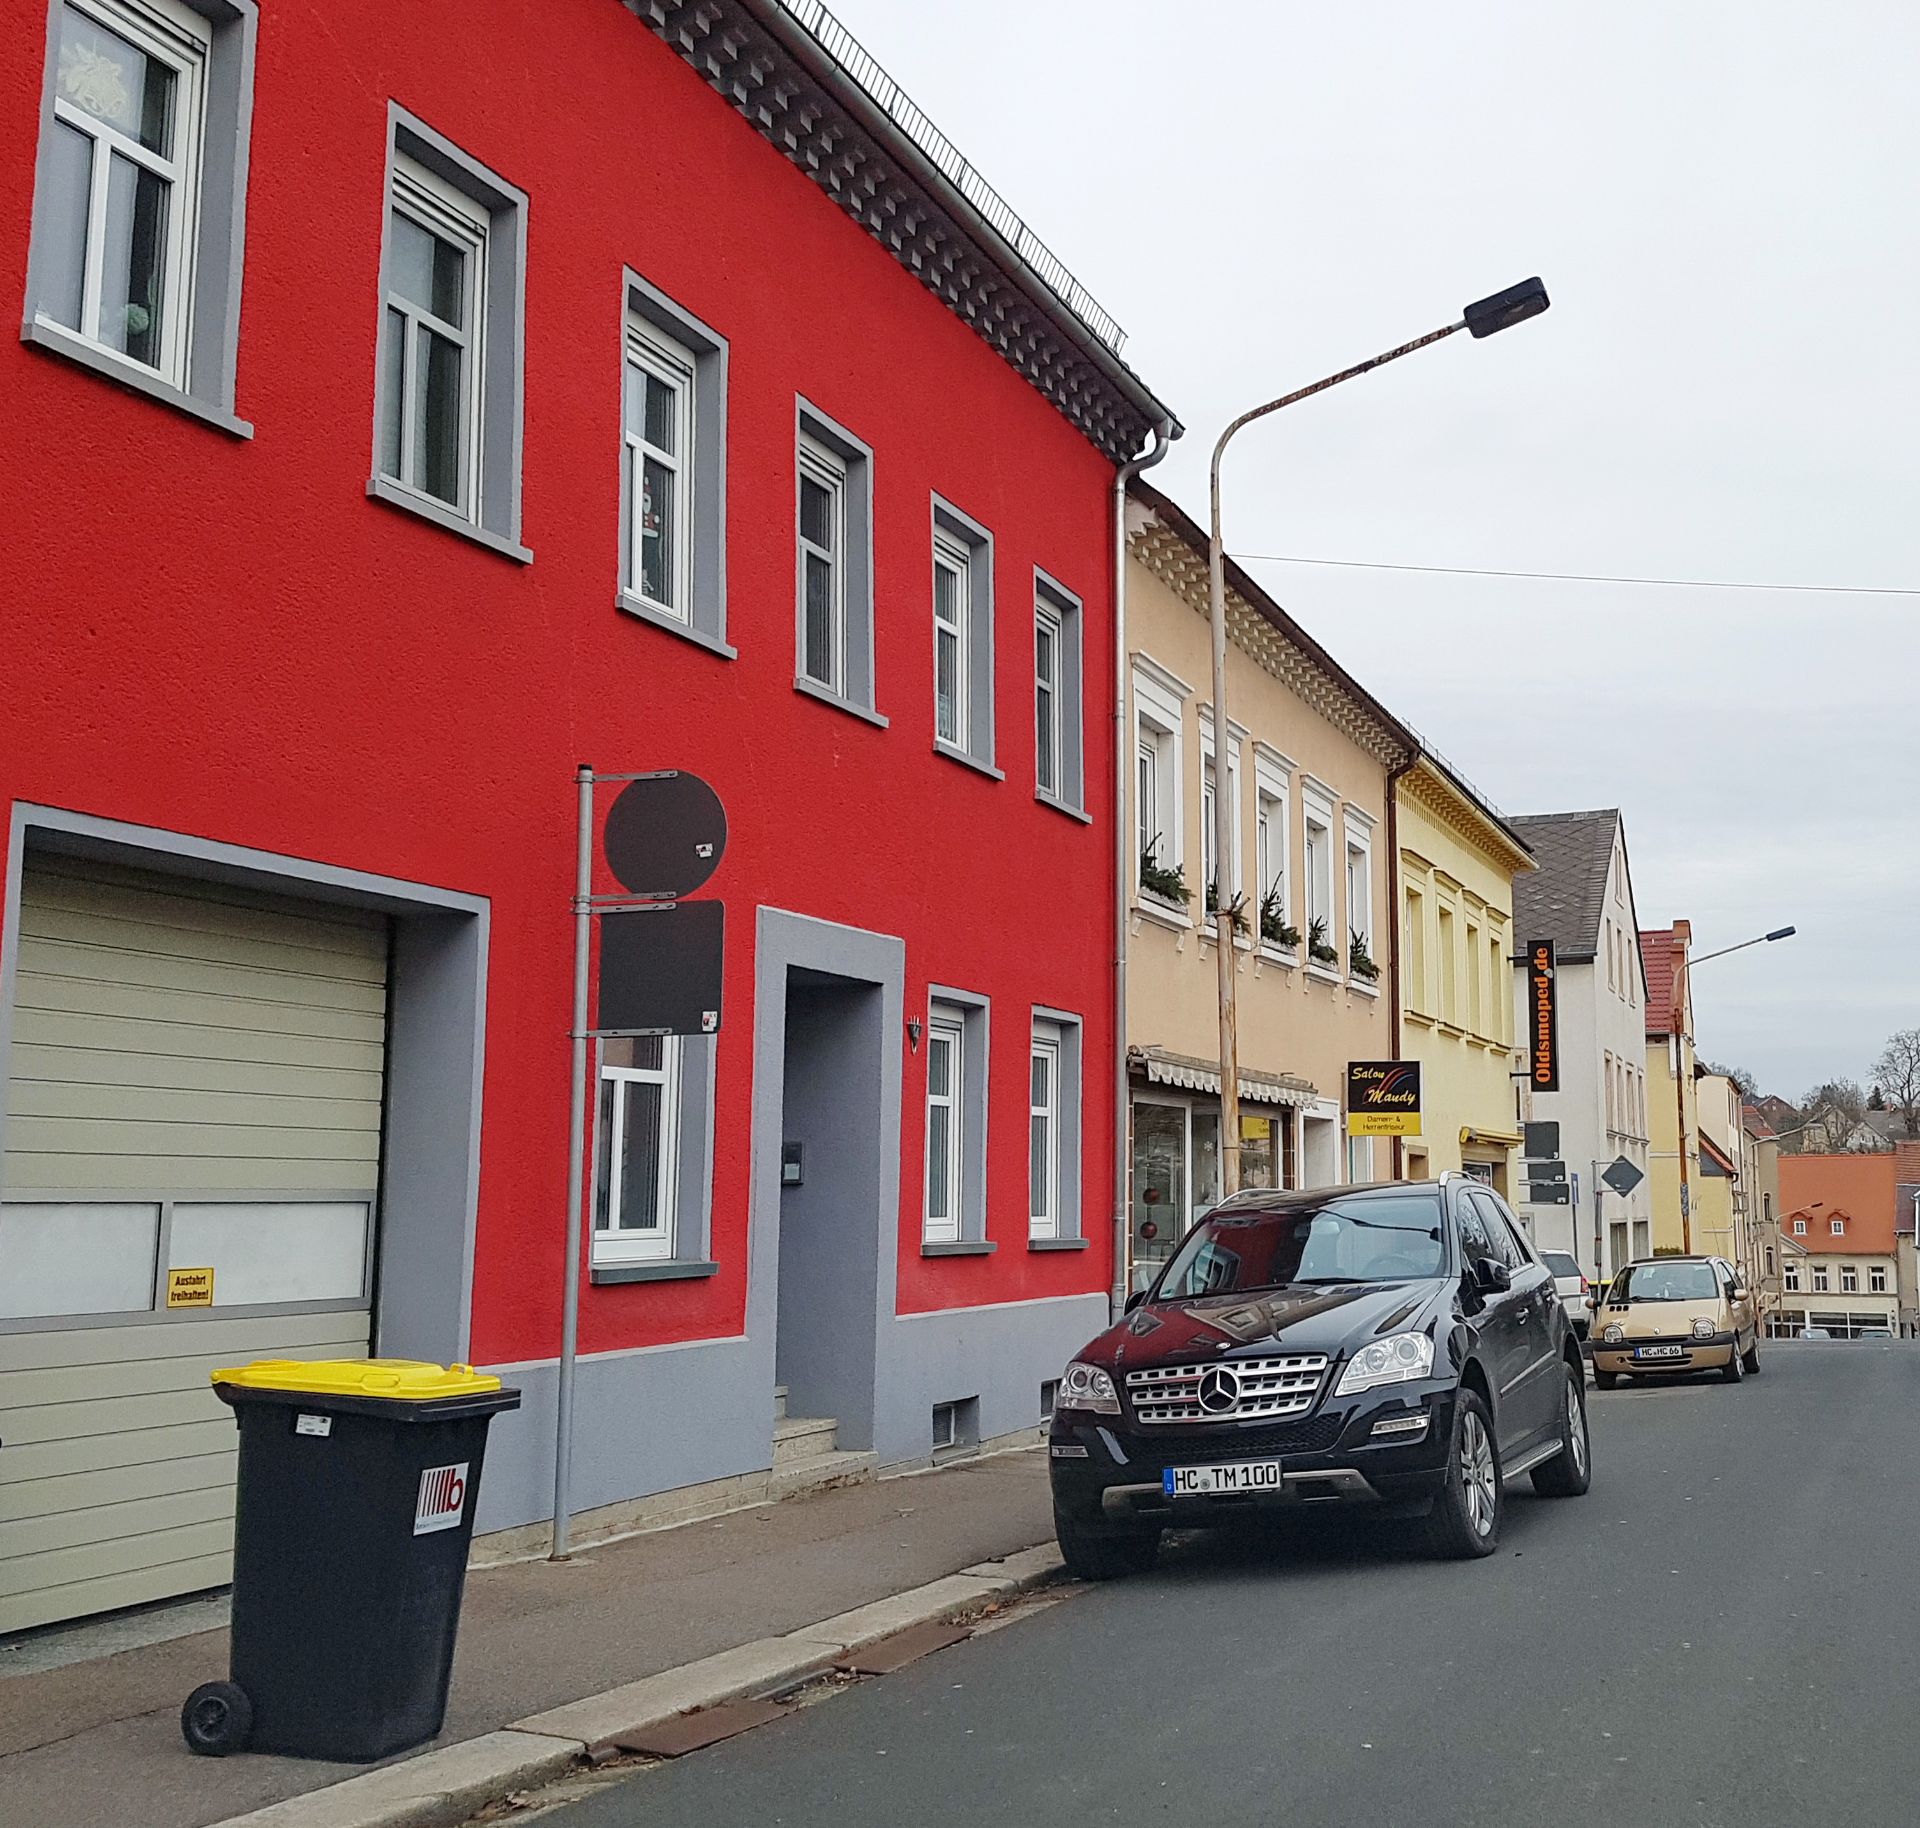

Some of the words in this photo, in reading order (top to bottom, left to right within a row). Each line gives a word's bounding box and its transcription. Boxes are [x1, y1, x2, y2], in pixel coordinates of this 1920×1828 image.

[1533, 947, 1552, 1083] Oldsmopedde
[1351, 1067, 1385, 1080] Salon
[1368, 1089, 1416, 1106] Mandy
[175, 1275, 206, 1286] Ausfahrt
[1641, 1348, 1652, 1356] HC
[1669, 1347, 1680, 1355] 66
[1174, 1469, 1199, 1490] HC
[1211, 1467, 1237, 1488] TM
[1241, 1464, 1278, 1487] 100
